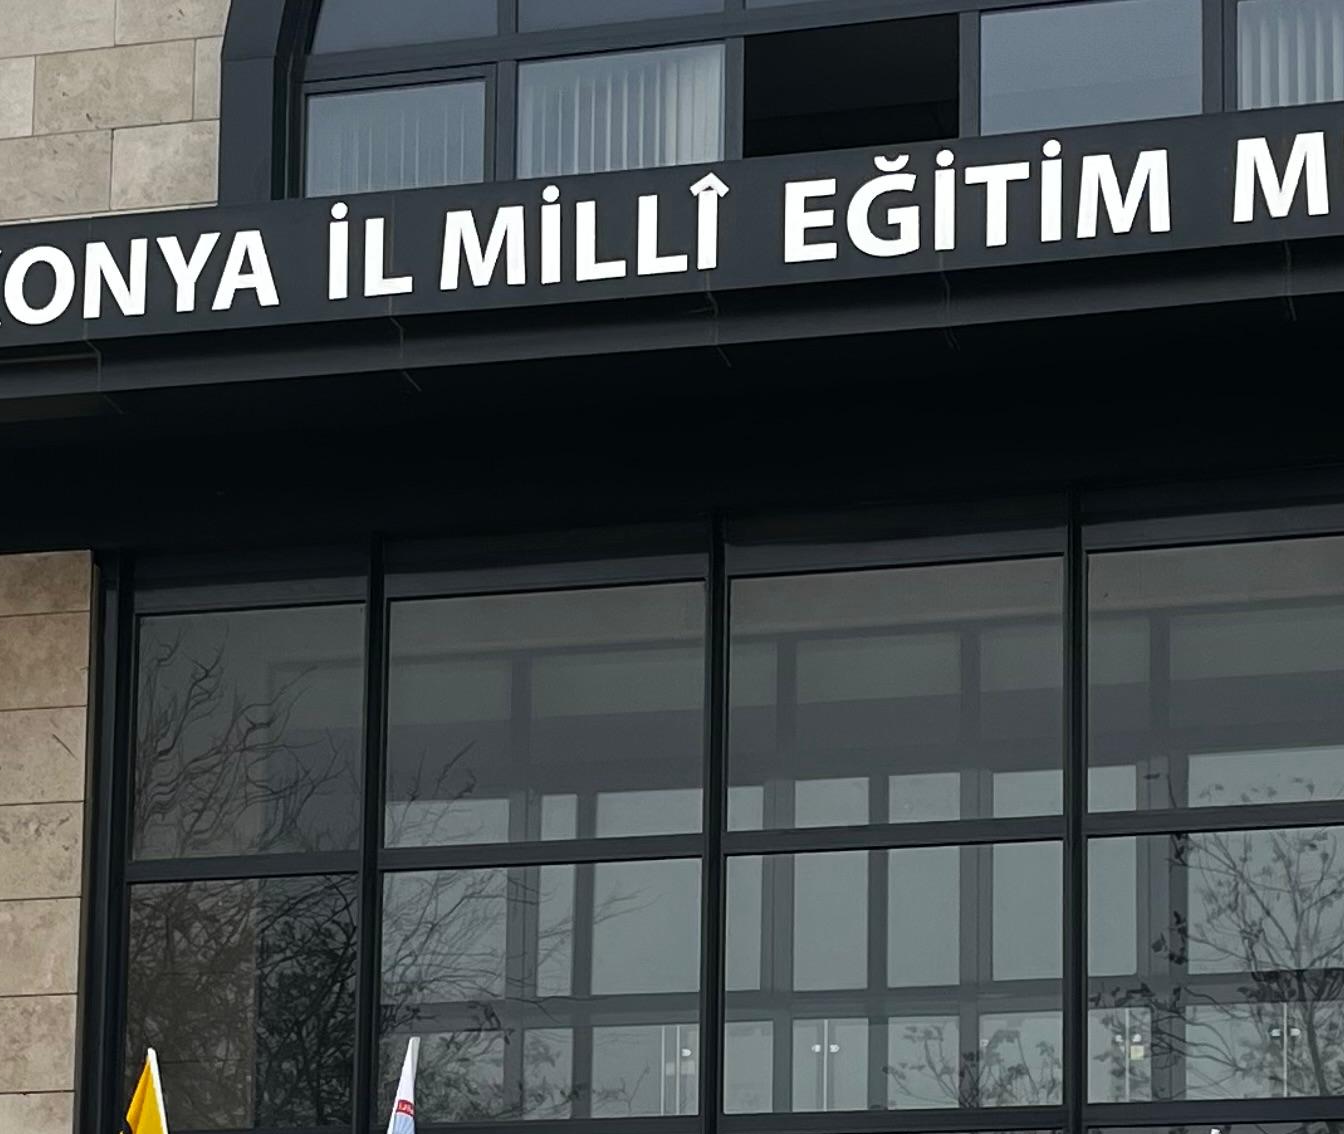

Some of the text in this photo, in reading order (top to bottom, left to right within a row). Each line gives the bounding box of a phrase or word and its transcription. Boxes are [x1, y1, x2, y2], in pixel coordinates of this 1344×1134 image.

[328, 201, 414, 301] İL
[439, 171, 730, 291] MİLLÎ
[783, 138, 1171, 264] EĞİTİM
